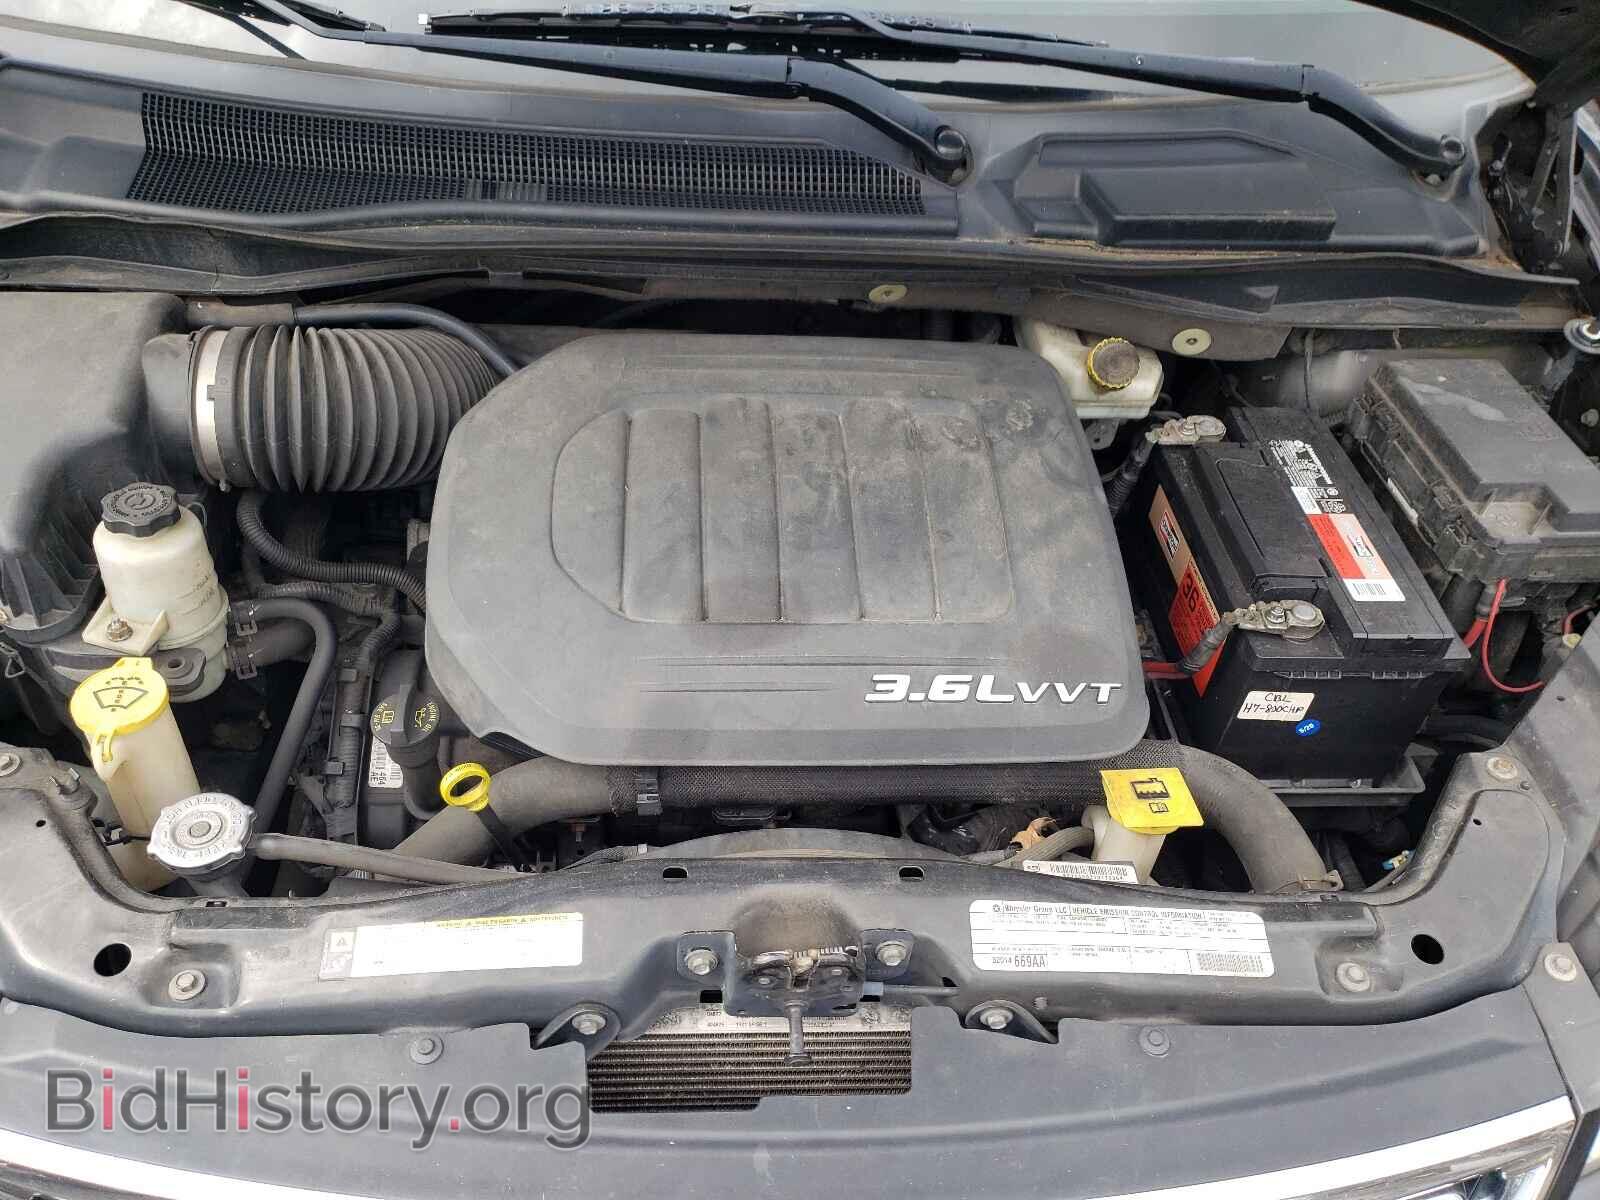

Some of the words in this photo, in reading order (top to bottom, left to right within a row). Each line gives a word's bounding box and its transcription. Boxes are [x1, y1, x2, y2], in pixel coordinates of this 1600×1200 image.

[865, 674, 1014, 704] 3.6L
[1016, 682, 1122, 705] VVT
[1014, 954, 1046, 968] 669AA
